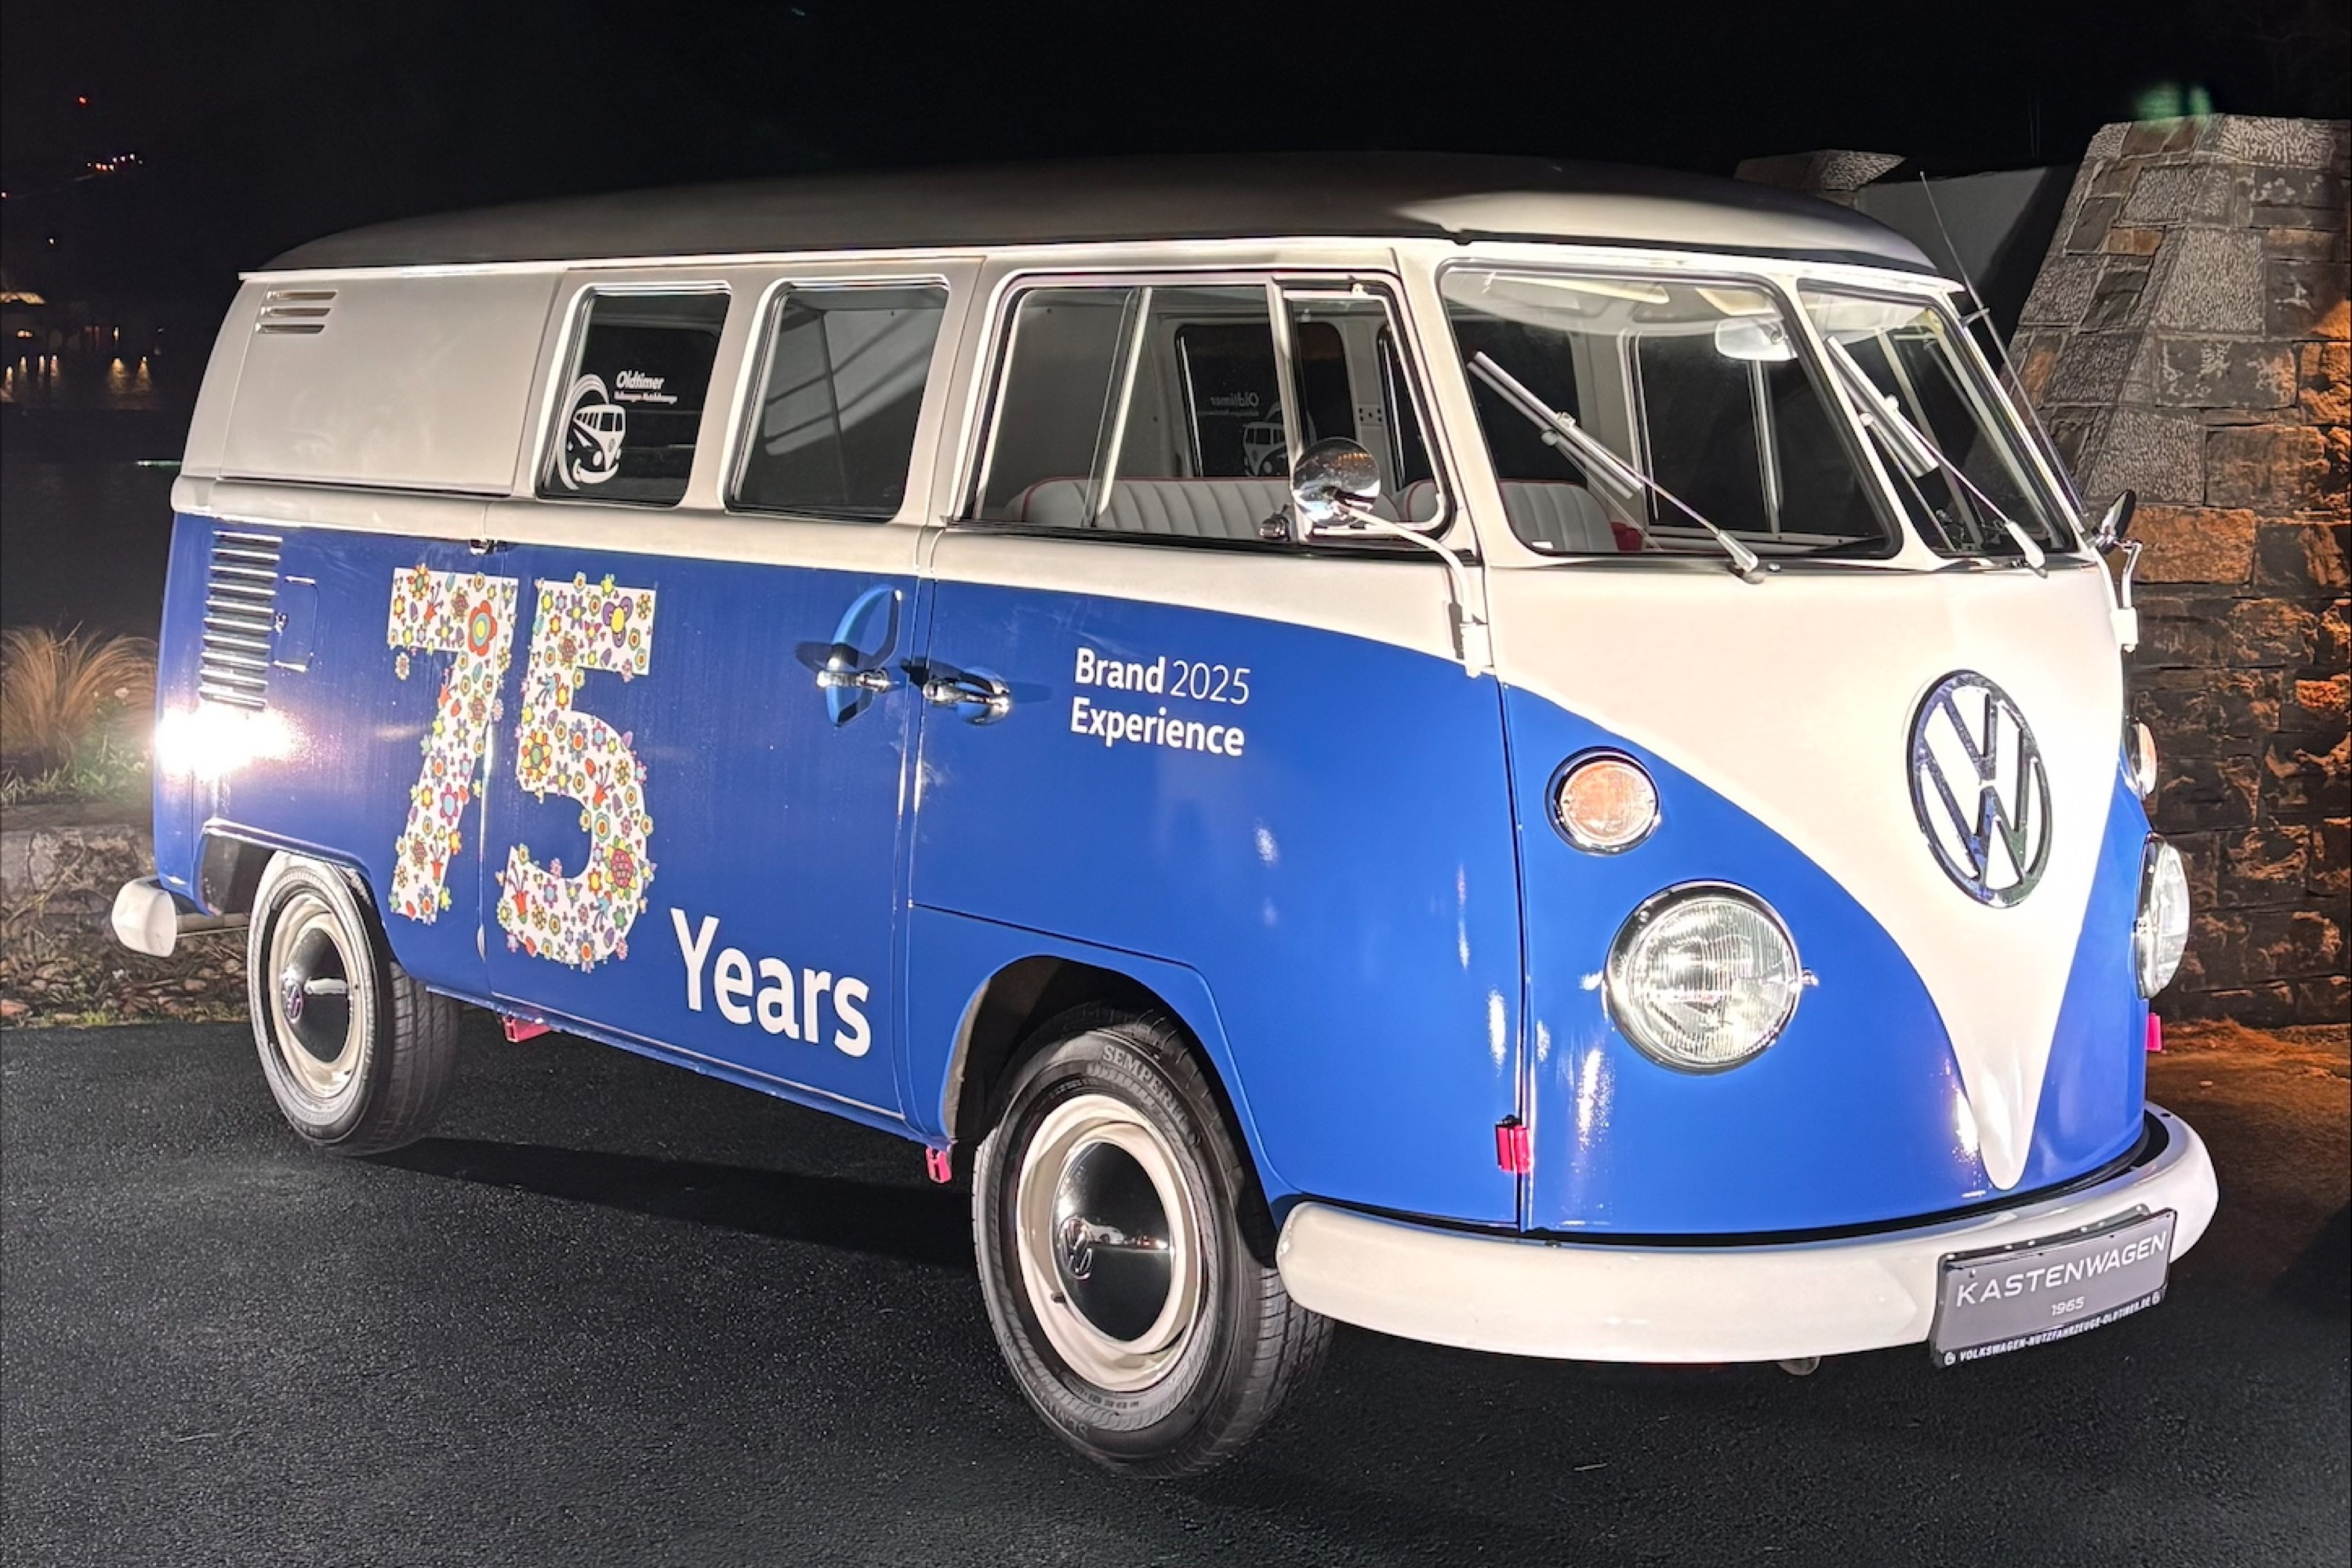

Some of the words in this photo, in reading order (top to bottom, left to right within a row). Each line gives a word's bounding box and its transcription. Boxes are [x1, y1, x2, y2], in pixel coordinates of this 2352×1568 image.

[616, 370, 665, 390] Oldtimer
[1075, 646, 1166, 694] Brand
[1170, 659, 1250, 704] 2025
[1070, 696, 1245, 757] Experience
[387, 563, 657, 973] 75
[670, 907, 872, 1058] Years
[1956, 1230, 2167, 1308] KASTENWAGEN
[2051, 1296, 2085, 1316] 1965
